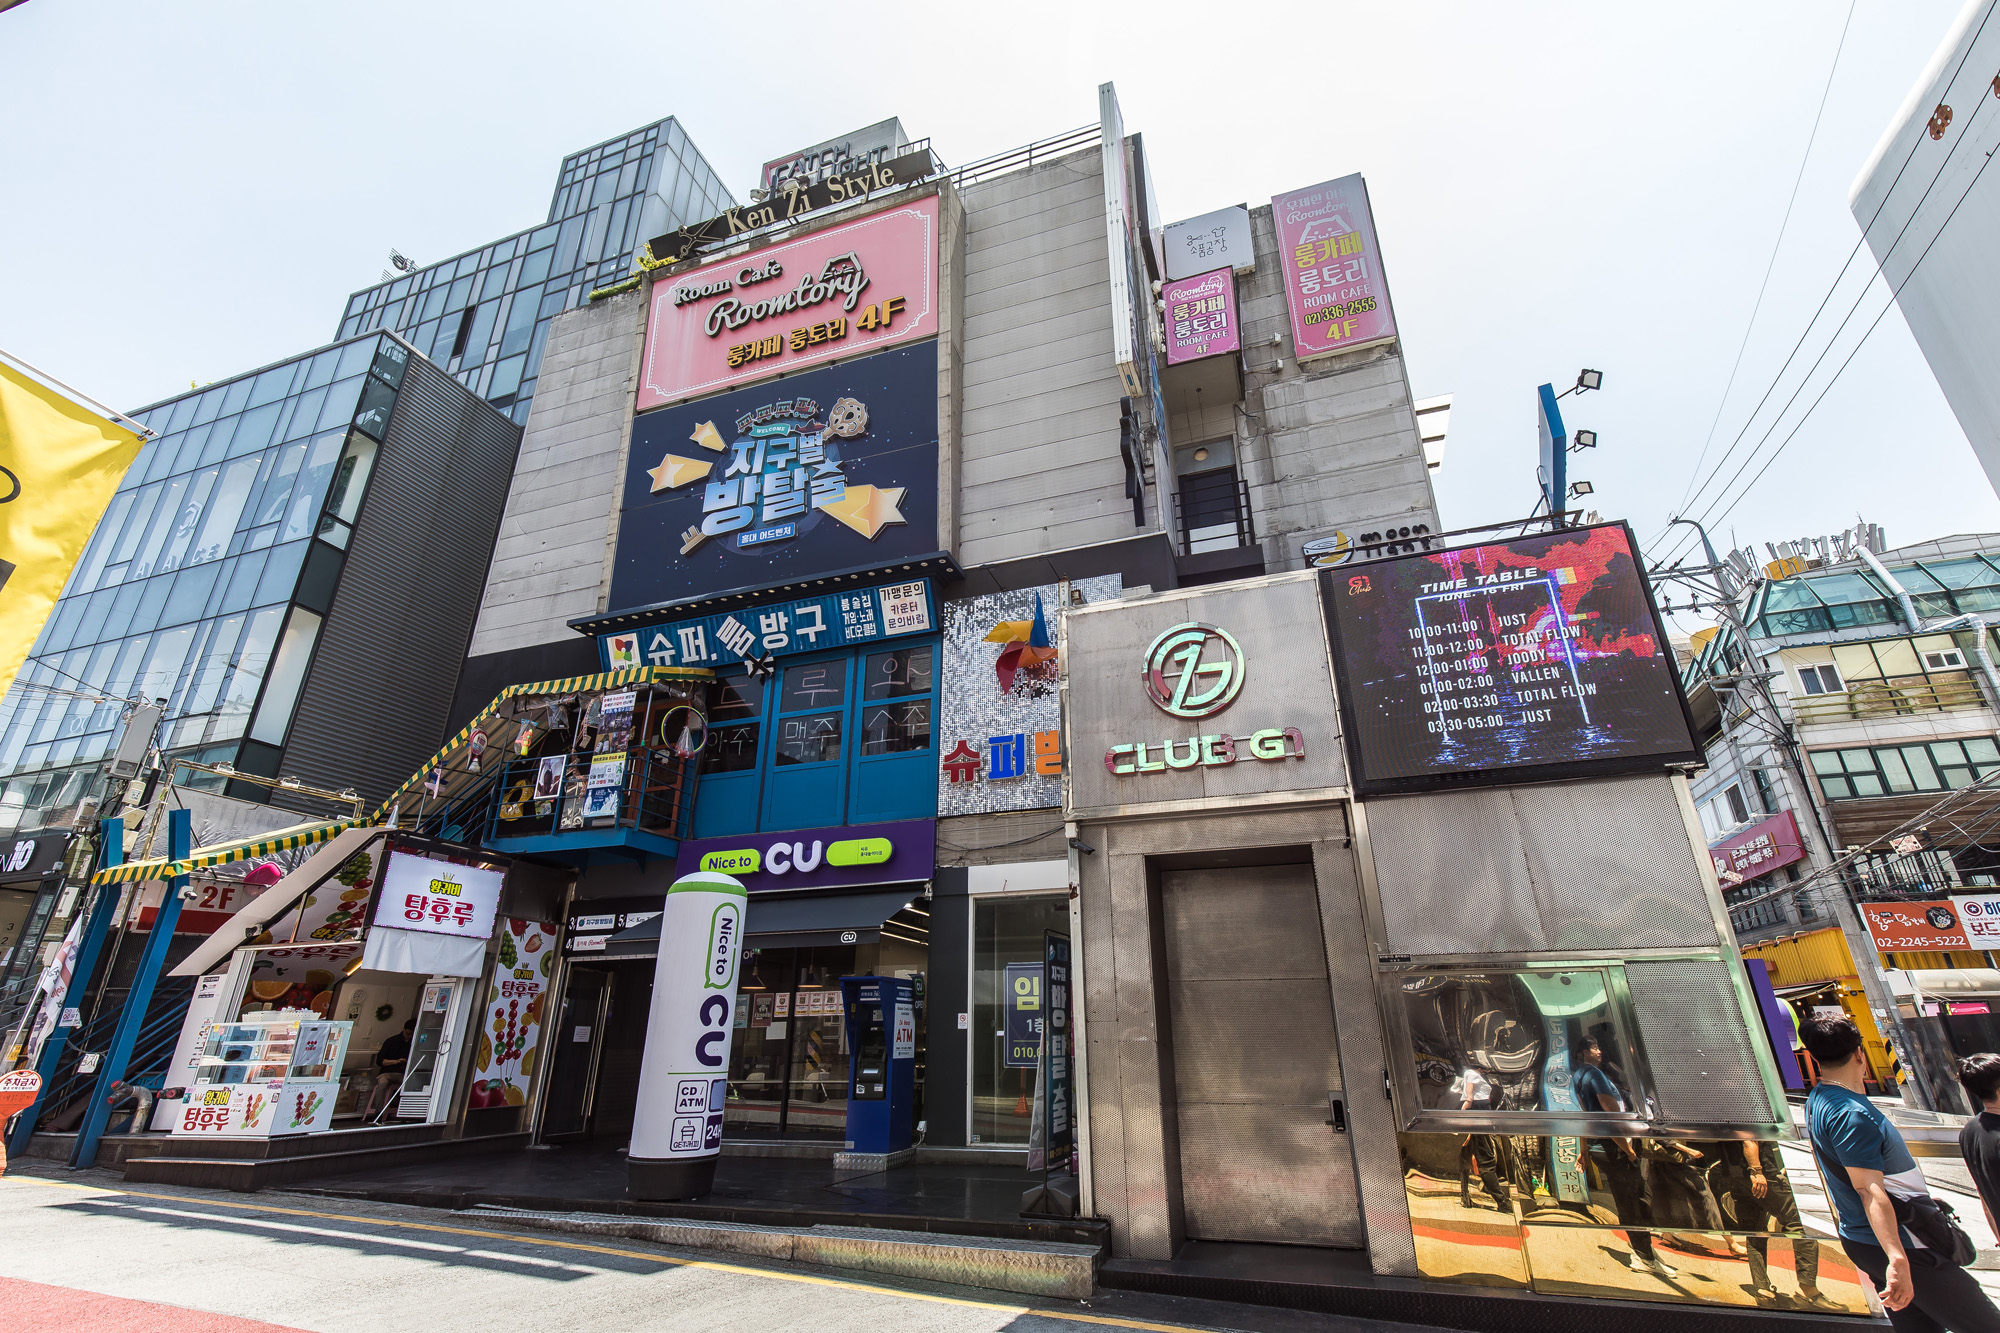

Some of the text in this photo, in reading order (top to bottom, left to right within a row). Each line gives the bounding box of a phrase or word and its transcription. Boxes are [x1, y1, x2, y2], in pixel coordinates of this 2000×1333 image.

[723, 162, 895, 236] Ken Zi Style
[1190, 237, 1228, 258] 소품공장
[1294, 232, 1363, 269] 룸카페
[674, 259, 782, 306] Room Cafe
[1298, 258, 1368, 294] 룸토리
[1170, 280, 1226, 301] Roomtory
[1303, 284, 1373, 309] ROOM CAFE
[705, 271, 869, 336] Roomtory
[1172, 294, 1226, 321] 룸카페
[1322, 296, 1377, 321] 336-2555
[726, 296, 906, 368] 룸카페 룸토리 4F
[1174, 312, 1228, 339] 룸토리
[1326, 319, 1359, 340] 4F
[1177, 329, 1229, 348] ROOM CAFE
[1196, 343, 1210, 354] 4F
[756, 425, 786, 434] WELCOME
[725, 432, 825, 478] 지구별
[701, 458, 848, 536] 방탈출
[1348, 584, 1372, 596] Club
[1421, 567, 1538, 594] TIME TABLE
[1503, 584, 1525, 593] FRI
[880, 582, 925, 601] 가맹문의
[890, 601, 919, 615] 카운터
[888, 613, 925, 629] 문의바람
[1498, 613, 1527, 627] JUST
[1502, 631, 1543, 646] TOTAL
[1545, 625, 1581, 641] FLOW
[1507, 649, 1546, 665] JOODY
[1511, 666, 1560, 684] VALLEN
[1516, 687, 1558, 704] TOTAL
[1561, 682, 1597, 698] FLOW
[1521, 709, 1552, 724] JUST
[785, 717, 838, 757] 맥주
[864, 705, 930, 745] 소주
[1104, 733, 1236, 775] CLUB
[708, 840, 823, 875] Nice to CU
[199, 885, 235, 910] 2F
[430, 878, 463, 898] 황귀비
[404, 893, 475, 927] 탕후루
[843, 932, 855, 942] CU
[1970, 922, 2000, 936] 보드
[715, 917, 734, 976] Nice to
[1877, 935, 1967, 948] 02-2245-5222
[501, 980, 540, 999] 탕후루
[1014, 976, 1040, 1011] 임
[695, 994, 729, 1067] CU
[896, 1028, 912, 1042] ATM
[4, 1078, 37, 1087] 주차금지
[681, 1086, 697, 1096] CD
[204, 1089, 231, 1106] 황귀비
[679, 1097, 704, 1108] ATM
[183, 1107, 230, 1132] 탕후루
